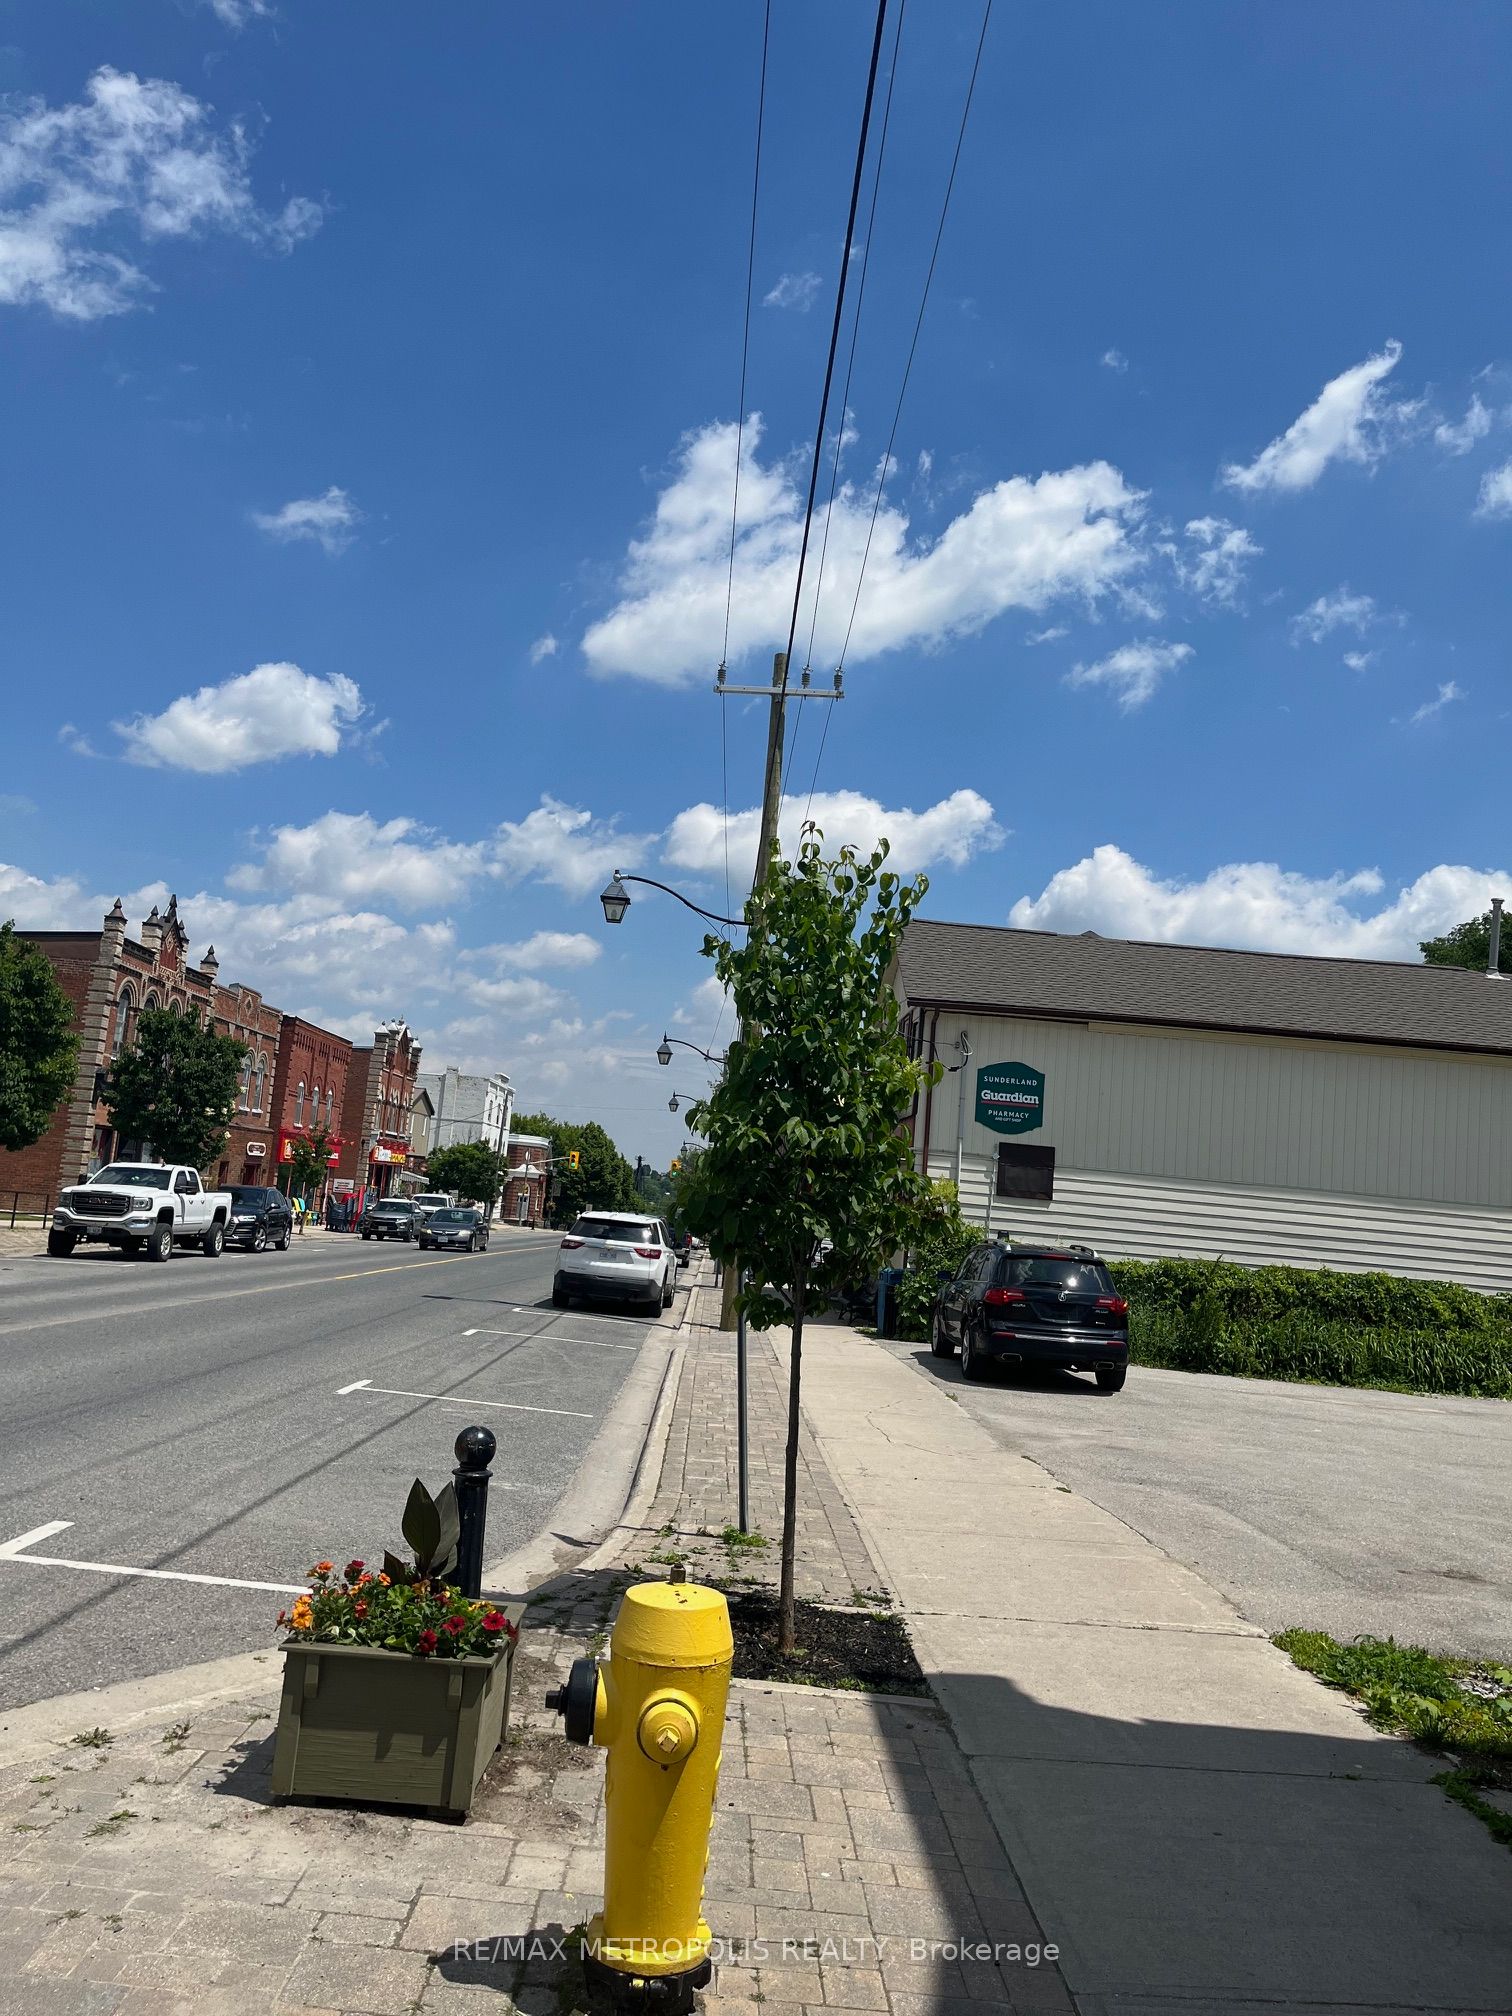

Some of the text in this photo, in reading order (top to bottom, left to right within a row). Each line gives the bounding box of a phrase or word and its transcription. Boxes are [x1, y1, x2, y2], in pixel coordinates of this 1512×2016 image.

[984, 1076, 1037, 1086] SUNDERLAND
[981, 1090, 1039, 1104] Guardian
[988, 1109, 1029, 1118] PHARMACY
